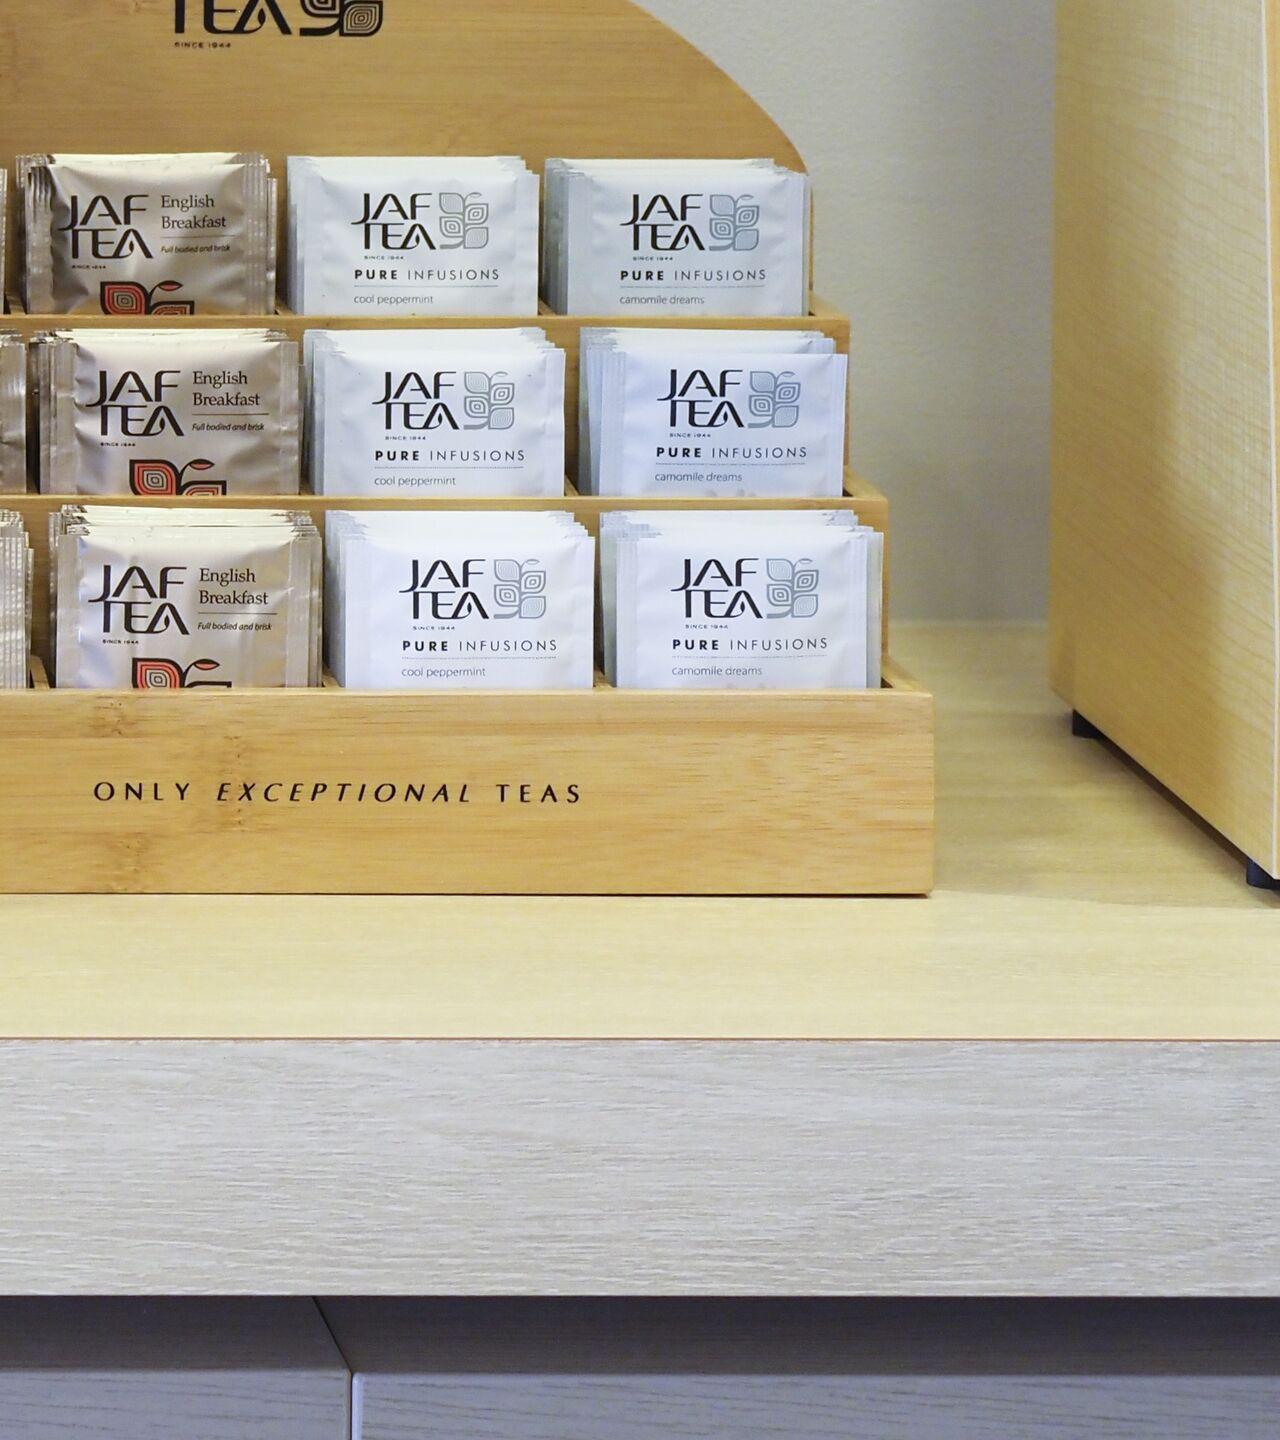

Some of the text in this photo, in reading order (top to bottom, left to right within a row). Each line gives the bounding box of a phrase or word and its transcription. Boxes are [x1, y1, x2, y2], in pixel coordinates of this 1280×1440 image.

[161, 195, 215, 211] English
[162, 215, 226, 228] Breakfast
[364, 223, 436, 250] TEA
[633, 224, 705, 251] TEA
[72, 228, 153, 259] TEA
[355, 269, 499, 280] PURE INFUSIONS
[621, 270, 766, 281] PURE INFUSIONS
[354, 294, 433, 305] cool peppermint
[620, 295, 704, 304] camomile dreams
[193, 371, 247, 388] English
[193, 392, 260, 406] Breakfast
[385, 402, 459, 429] TEA
[670, 399, 744, 427] TEA
[101, 405, 184, 436] TEA
[375, 450, 524, 461] PURE INFUSIONS
[657, 447, 807, 457] PURE INFUSIONS
[375, 477, 456, 486] cool peppermint
[655, 472, 742, 481] camomile dreams
[199, 568, 255, 586] English
[199, 591, 268, 604] Breakfast
[685, 590, 763, 618] TEA
[413, 591, 489, 619] TEA
[104, 601, 189, 635] TEA
[403, 640, 557, 651] PURE INFUSIONS
[672, 638, 827, 650] PURE INFUSIONS
[402, 667, 486, 678] cool peppermint
[672, 666, 762, 675] camomile dreams
[94, 782, 580, 803] ONLY EXCEPTIONAL TEAS
